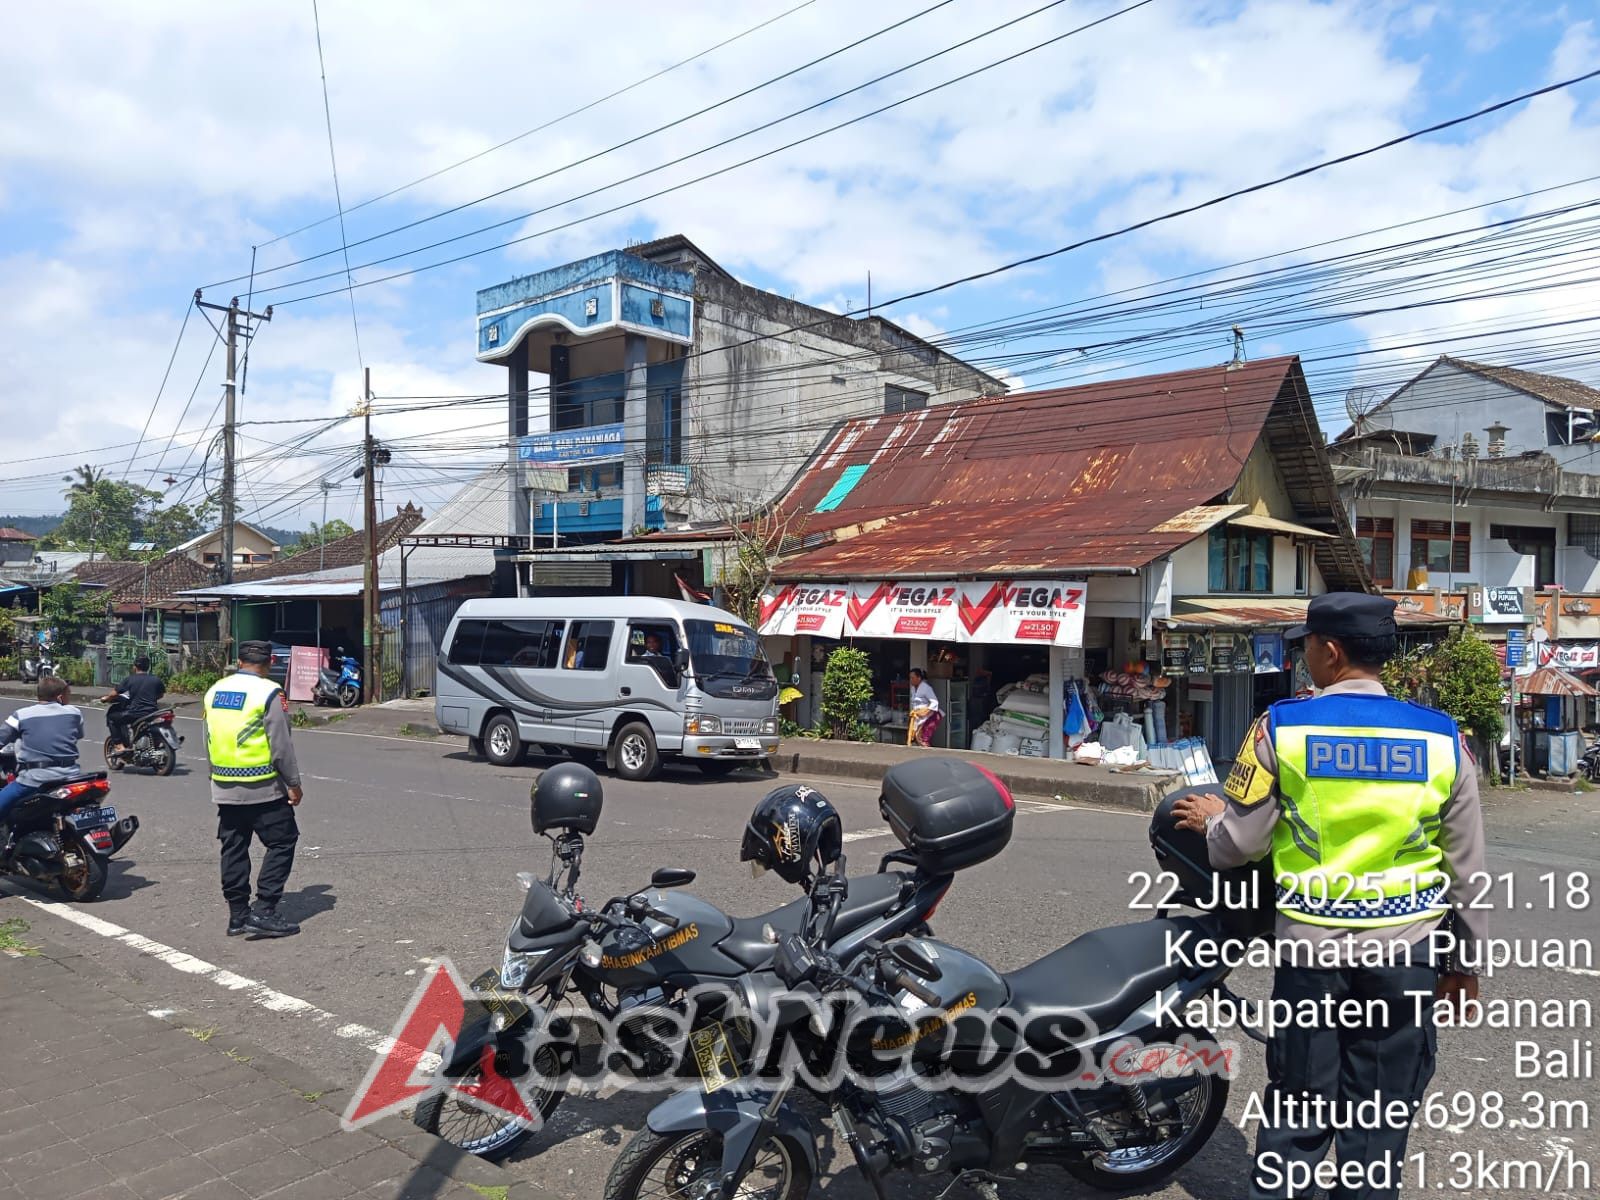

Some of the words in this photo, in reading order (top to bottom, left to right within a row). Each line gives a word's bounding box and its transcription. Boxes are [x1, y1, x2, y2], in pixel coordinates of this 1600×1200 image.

[885, 587, 957, 607] VEGAZ
[1001, 587, 1083, 609] VEGAZ
[214, 694, 245, 707] POLISI
[1311, 742, 1423, 774] POLISI
